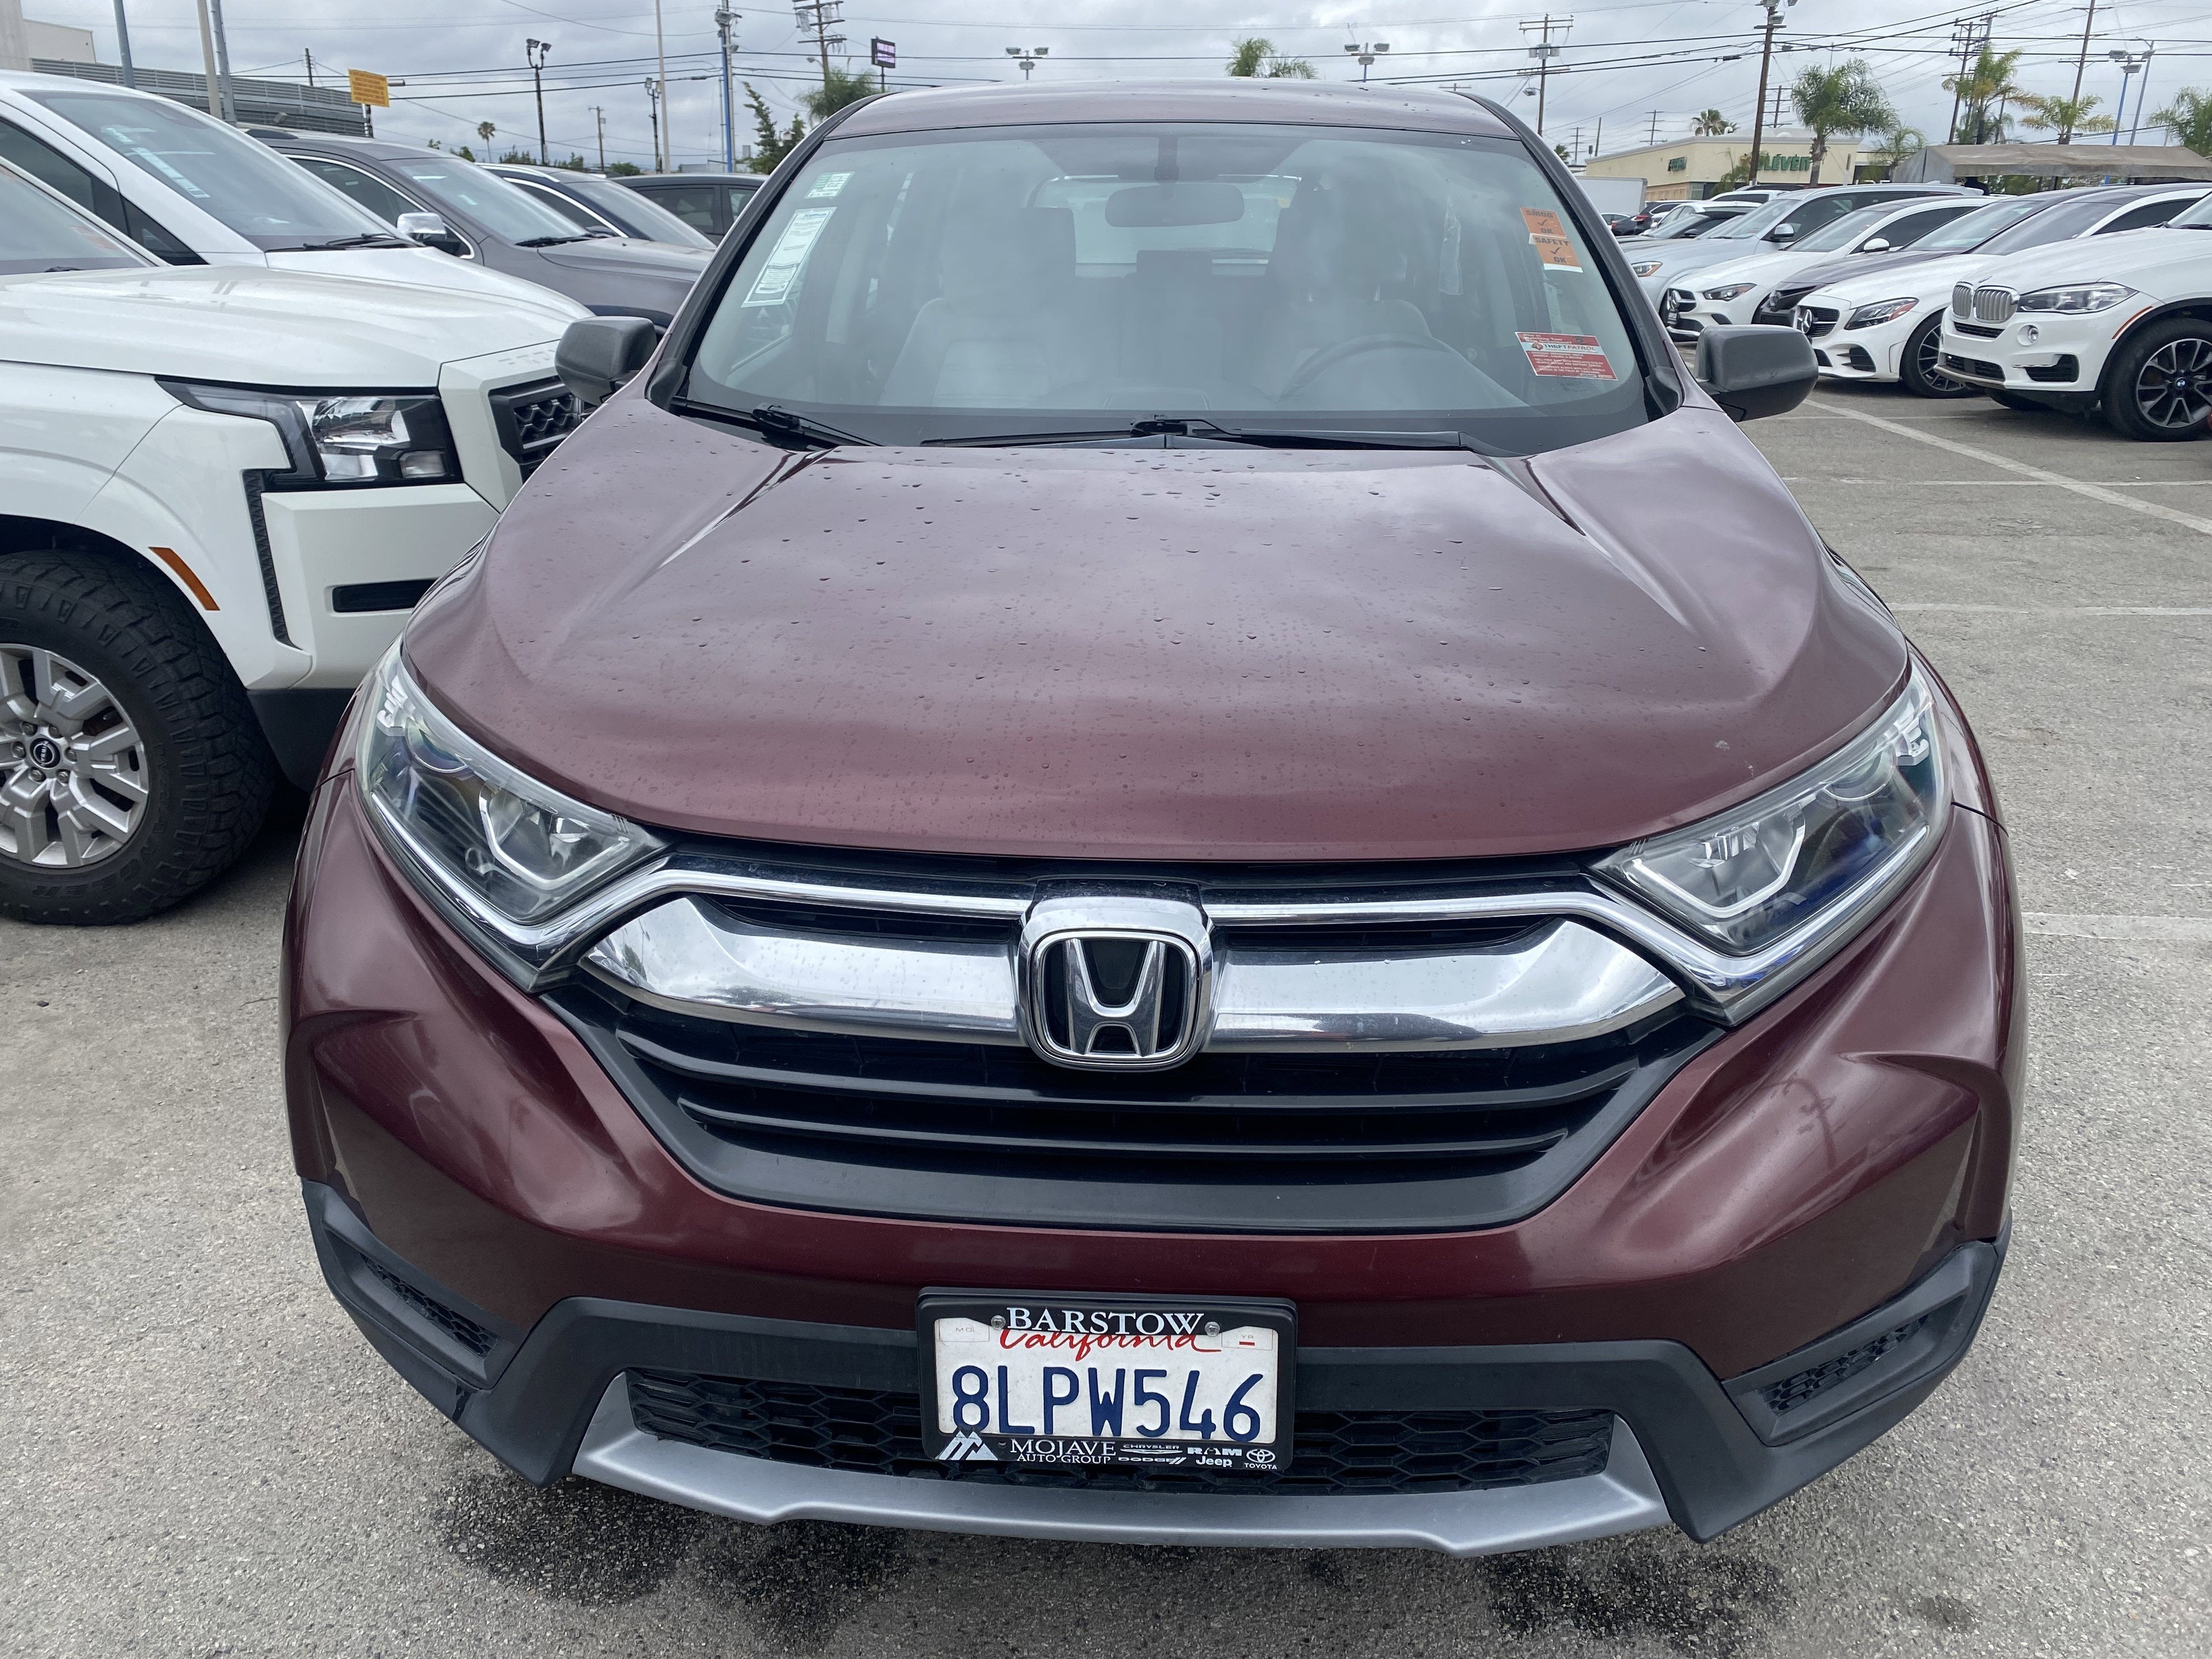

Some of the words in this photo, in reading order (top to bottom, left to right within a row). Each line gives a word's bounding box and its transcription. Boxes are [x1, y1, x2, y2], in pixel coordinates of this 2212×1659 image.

[1526, 210, 1554, 218] SMOG
[1535, 238, 1570, 246] SAFETY
[1006, 1307, 1204, 1335] BARSTOW
[1000, 1328, 1222, 1361] California
[952, 1365, 1263, 1442] 8LPW546
[1010, 1438, 1116, 1458] MOJAVE
[1187, 1447, 1243, 1457] RAM
[1017, 1454, 1057, 1463] AUTO
[1061, 1455, 1111, 1464] GROUP
[1196, 1455, 1232, 1468] Jeep
